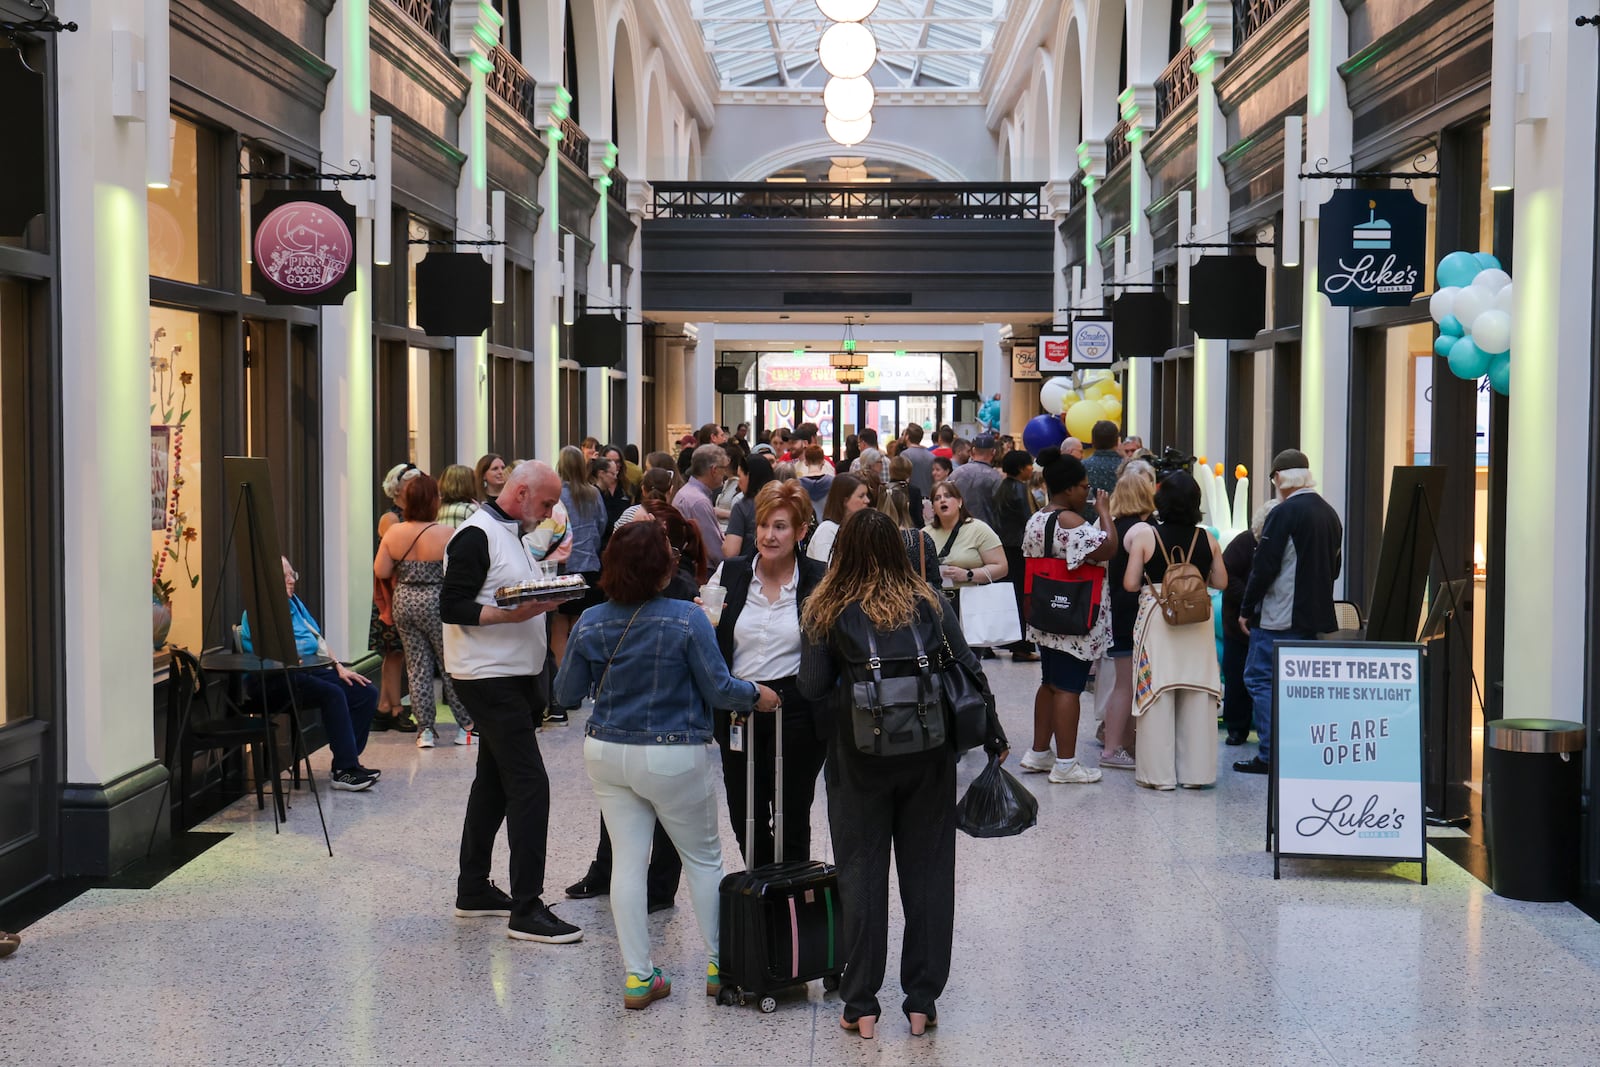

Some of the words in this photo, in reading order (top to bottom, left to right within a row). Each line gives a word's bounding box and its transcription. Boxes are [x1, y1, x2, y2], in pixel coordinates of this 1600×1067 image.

[285, 266, 321, 275] MOON
[291, 256, 320, 266] PINK
[286, 274, 321, 284] GOODS
[1324, 253, 1418, 294] Luke's
[1285, 660, 1342, 678] SWEET
[1346, 661, 1412, 680] TREATS
[1286, 686, 1325, 699] UNDER
[1327, 687, 1350, 700] THE
[1353, 688, 1412, 701] SKYLIGHT
[1311, 723, 1338, 744] WE
[1351, 718, 1389, 740] ARE
[1323, 742, 1376, 765] OPEN
[1296, 794, 1405, 837] Luke's
